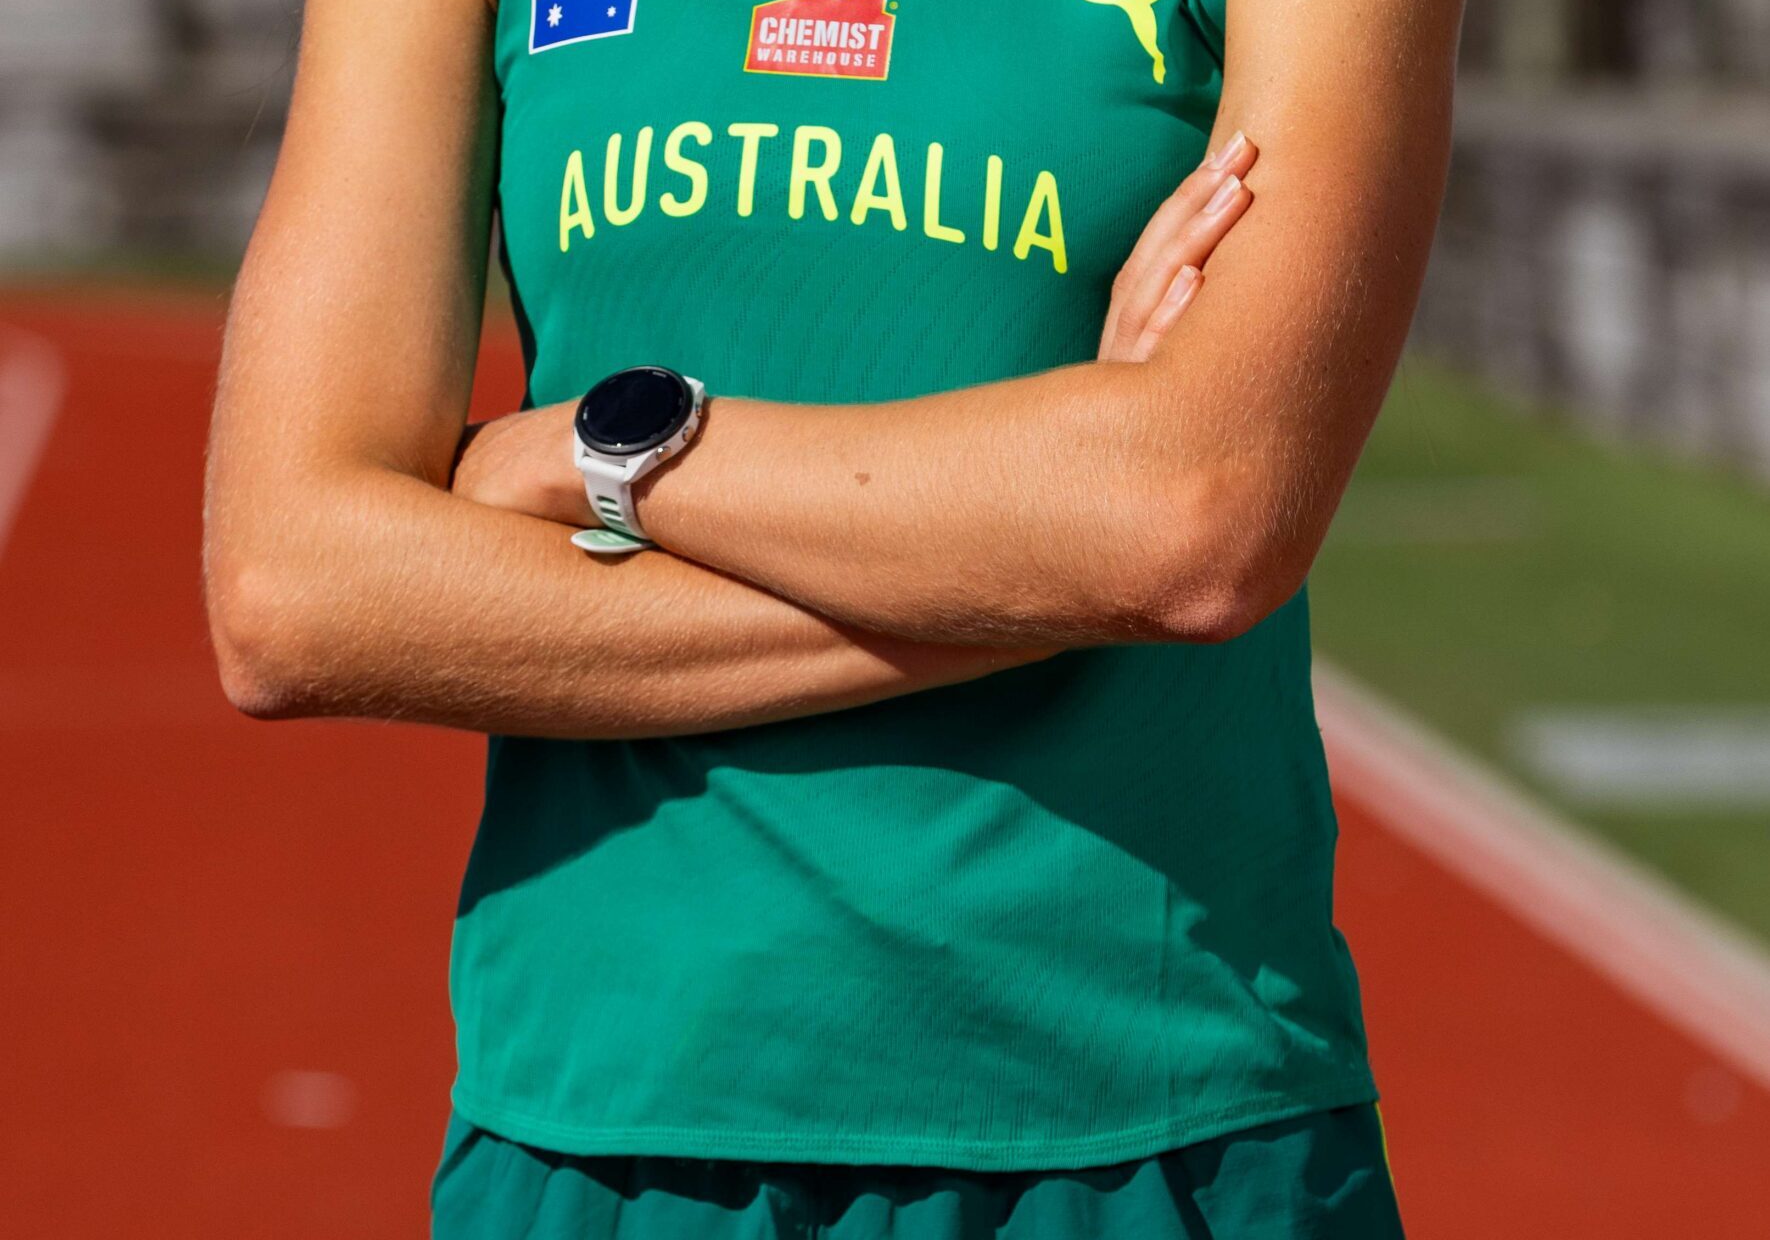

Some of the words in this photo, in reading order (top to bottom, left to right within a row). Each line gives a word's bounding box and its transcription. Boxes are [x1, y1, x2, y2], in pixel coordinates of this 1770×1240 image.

[759, 17, 885, 50] CHEMIST
[757, 48, 877, 68] WAREHOUSE
[559, 121, 1068, 274] AUSTRALIA
